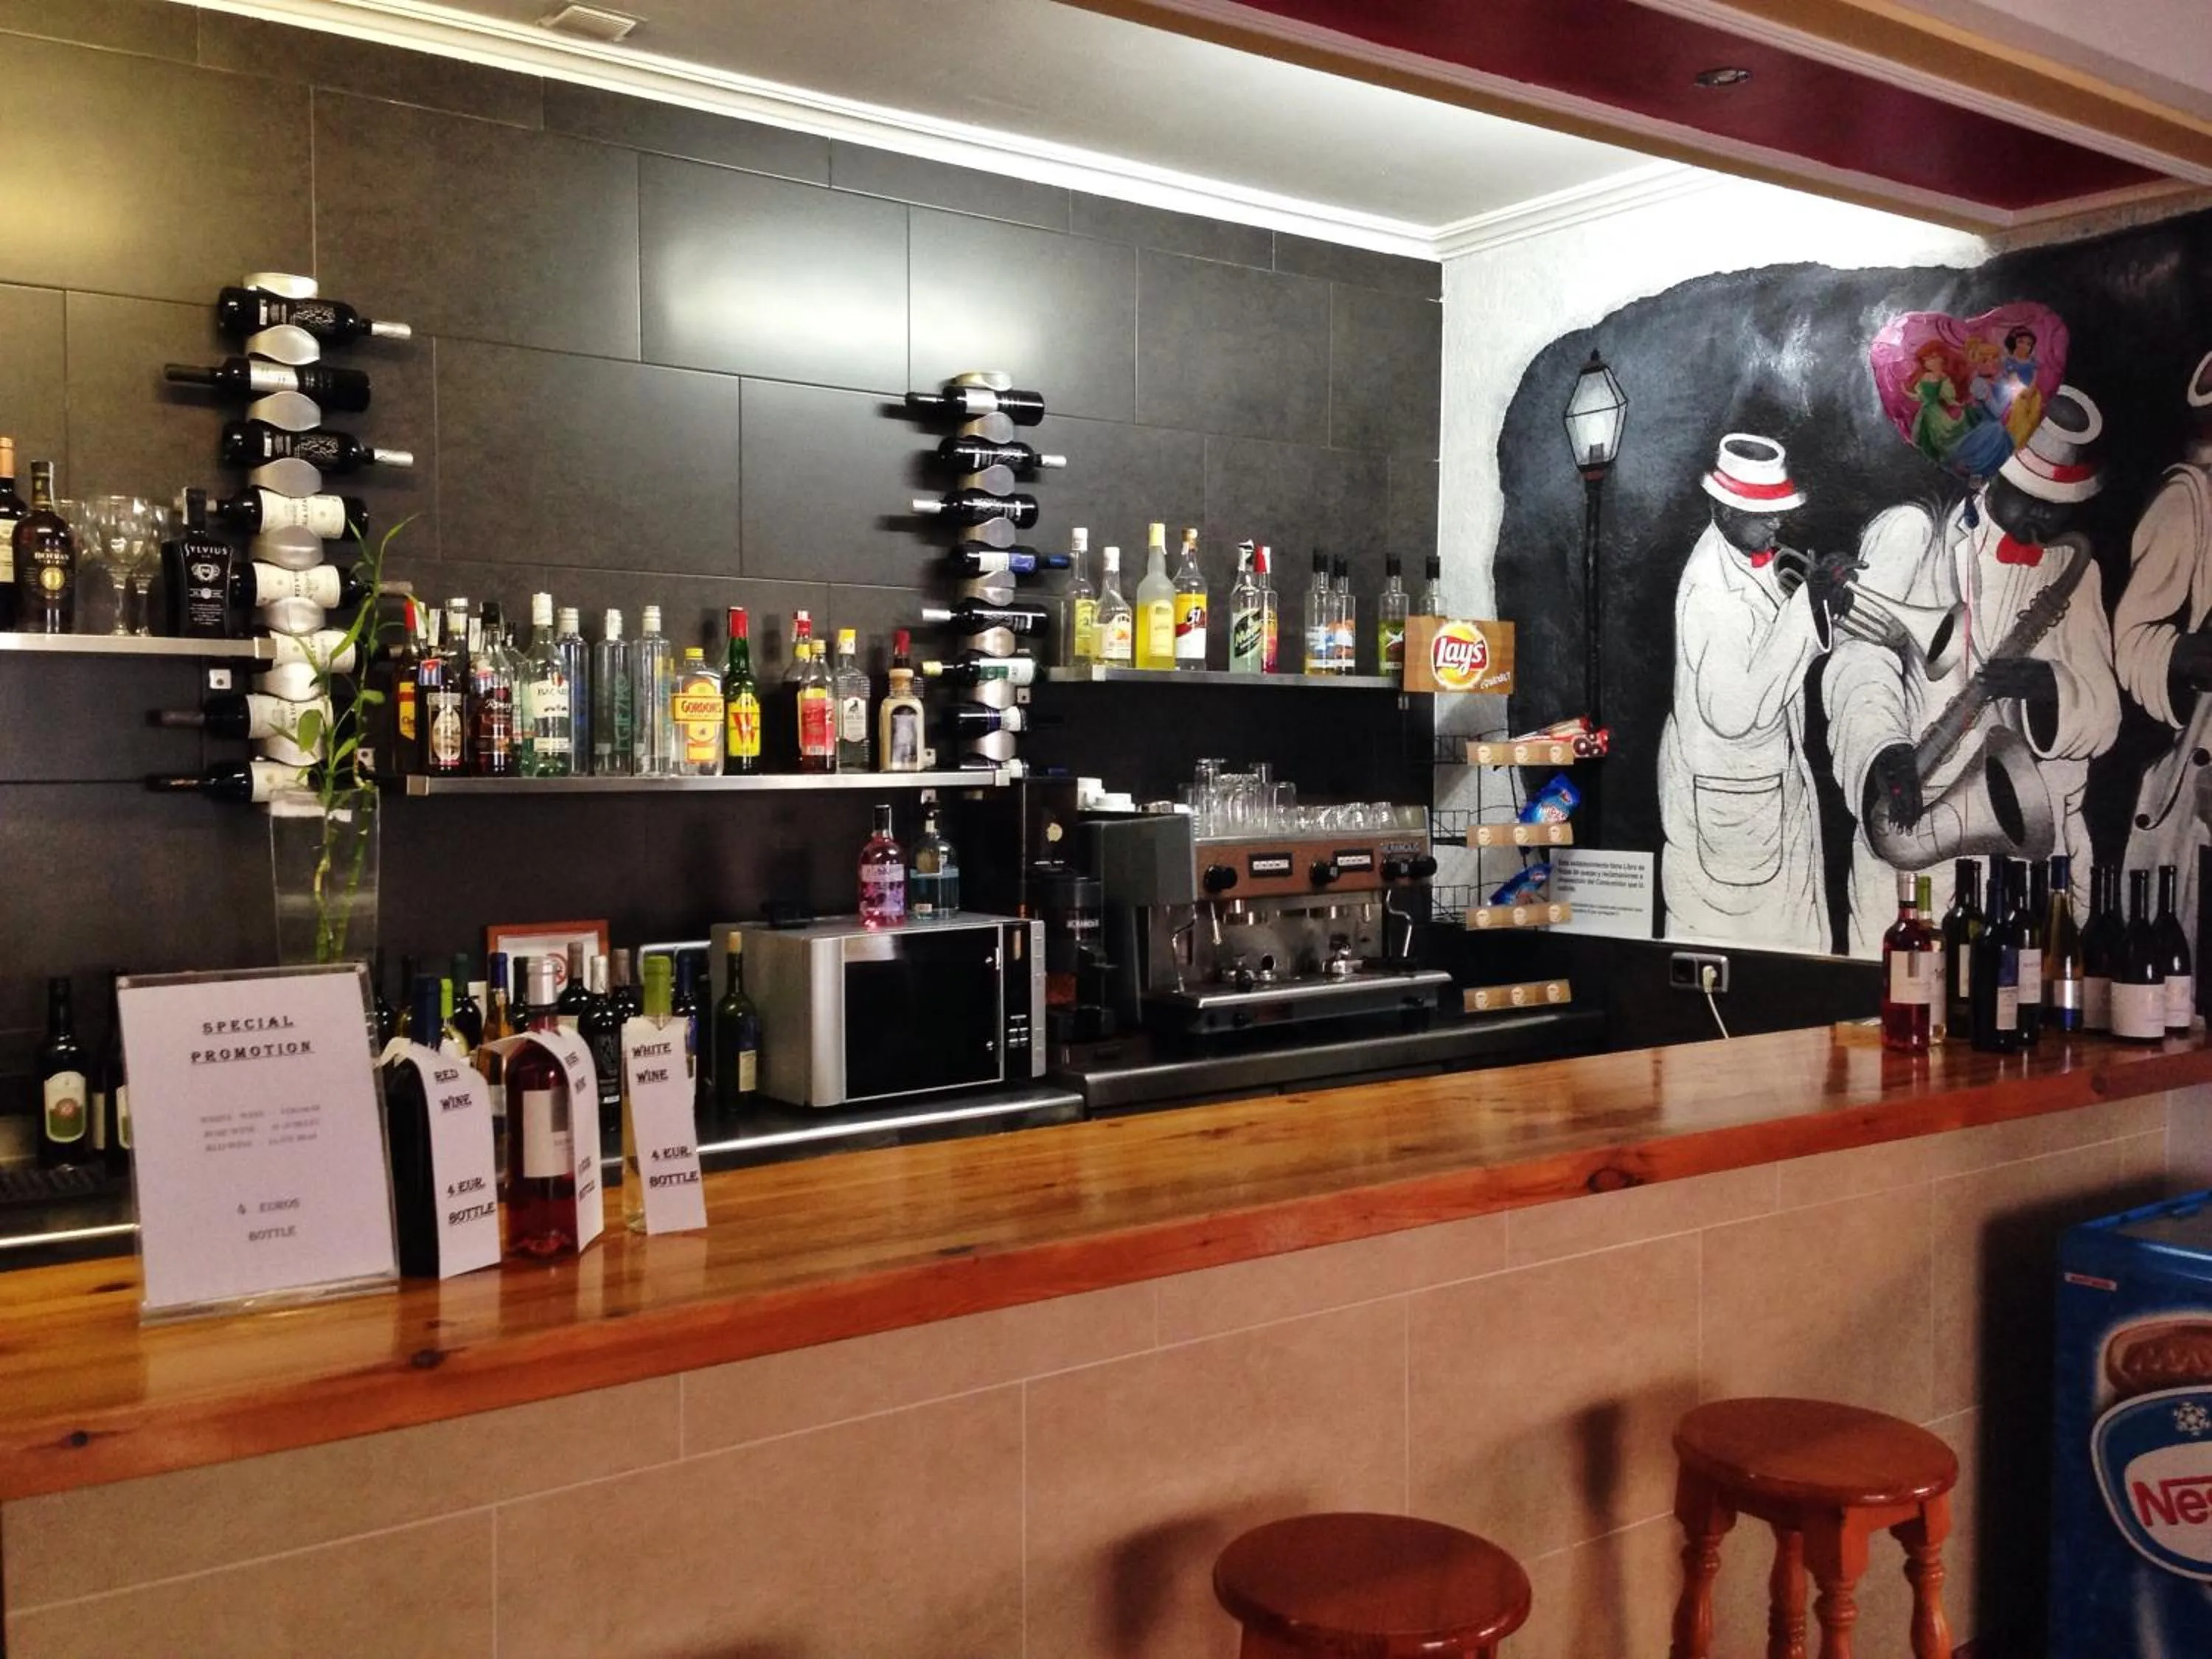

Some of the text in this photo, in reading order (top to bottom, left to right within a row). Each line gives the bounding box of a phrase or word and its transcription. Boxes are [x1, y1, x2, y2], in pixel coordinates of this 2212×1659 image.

[184, 543, 228, 557] SYLVIUS
[1436, 637, 1485, 676] Lay's
[202, 1015, 295, 1035] SPECIAL
[190, 1040, 313, 1063] PROMOTION
[632, 1043, 672, 1057] WHITE
[434, 1069, 459, 1082] RED
[636, 1069, 668, 1083] WINE
[440, 1093, 473, 1110] WINE
[651, 1150, 659, 1161] 4
[649, 1171, 699, 1186] BOTTLE
[259, 1198, 300, 1214] EUROS
[448, 1202, 496, 1224] BOTTLE
[248, 1225, 297, 1242] BOTTLE
[2132, 1475, 2212, 1527] Ne
